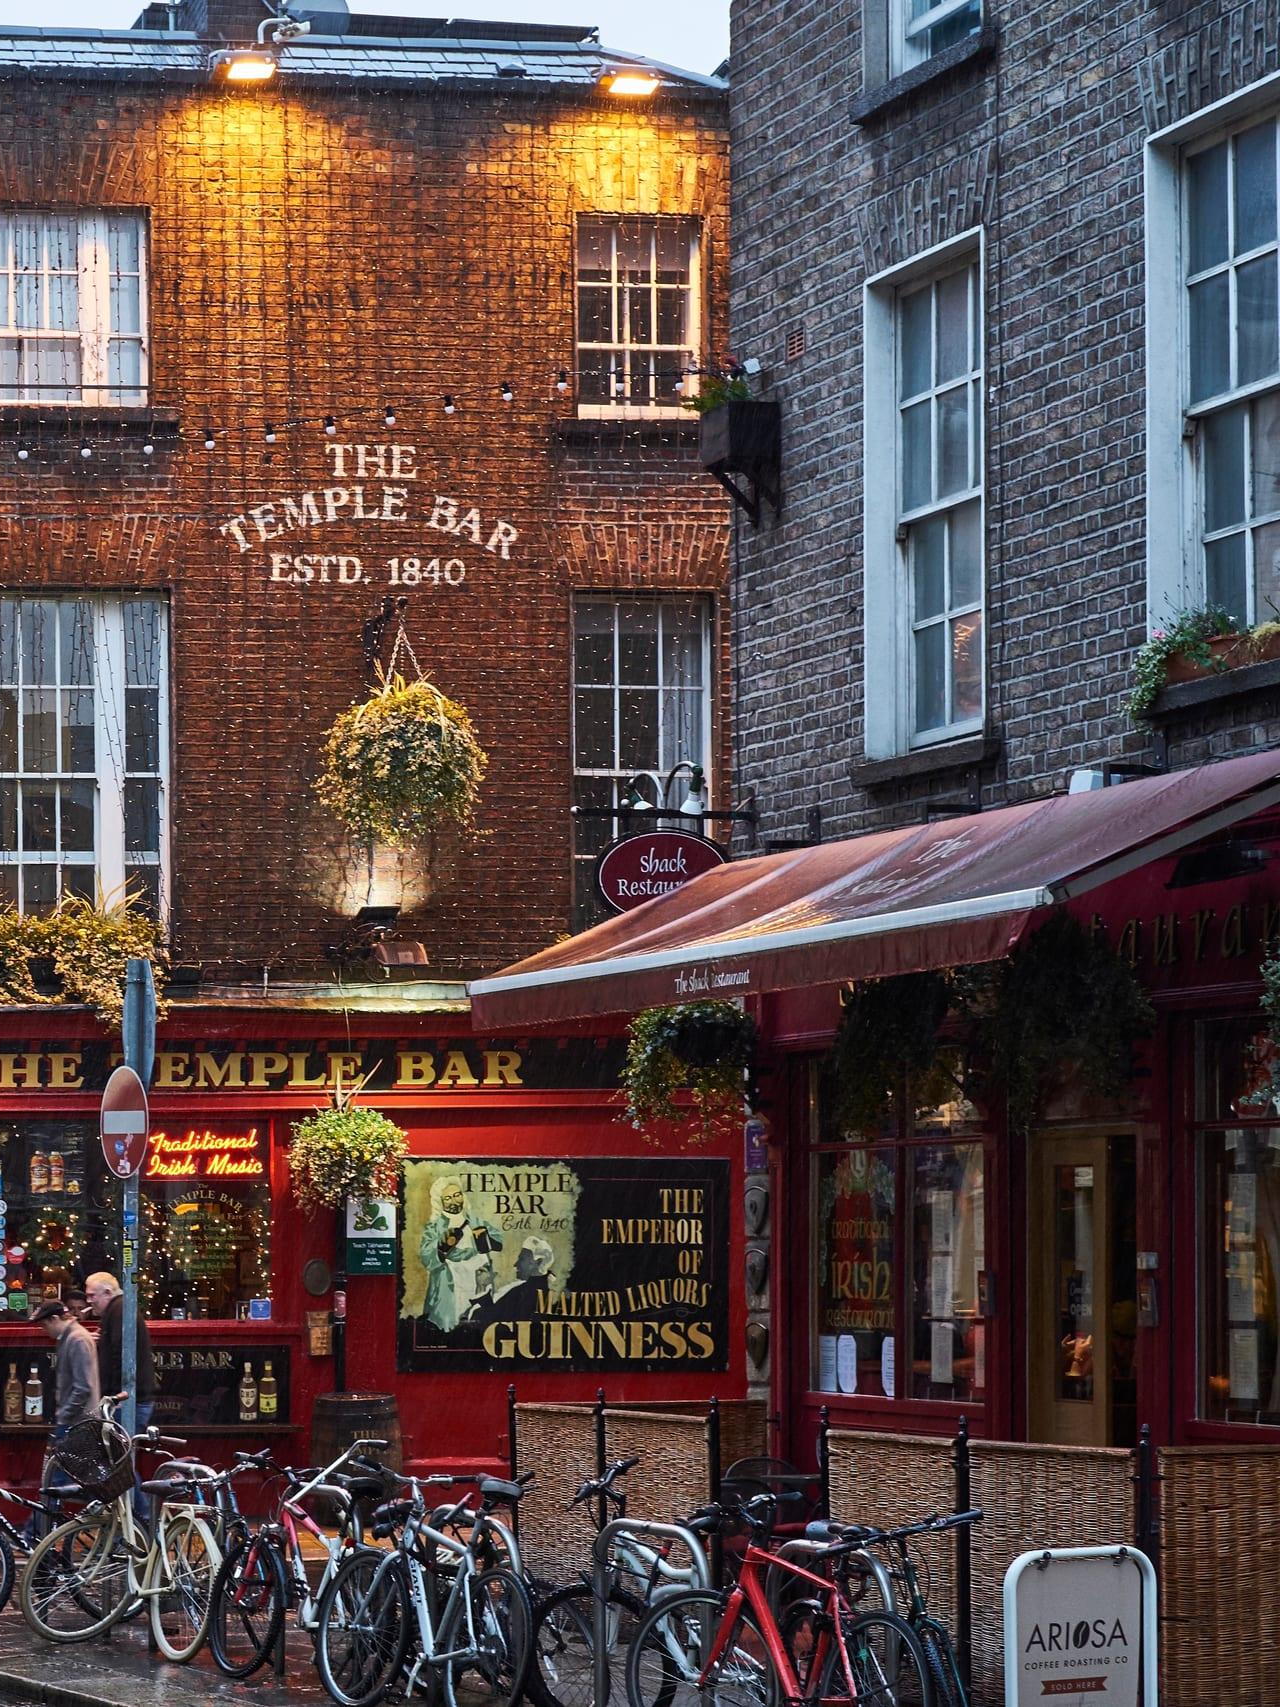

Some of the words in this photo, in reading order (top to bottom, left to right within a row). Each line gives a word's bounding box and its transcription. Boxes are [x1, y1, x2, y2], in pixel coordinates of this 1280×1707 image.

[325, 443, 418, 479] THE
[220, 486, 408, 553] TEMPLE
[427, 495, 519, 560] BAR
[269, 554, 372, 585] ESTD.
[387, 557, 466, 586] 1840
[640, 847, 688, 876] Shack
[617, 879, 684, 897] Restau
[674, 970, 689, 996] The
[110, 1051, 365, 1088] EMPLE
[395, 1050, 524, 1086] BAR
[149, 1128, 258, 1153] Traditional
[146, 1154, 197, 1176] Irish
[206, 1153, 264, 1174] Music
[460, 1173, 574, 1194] TEMPLE
[167, 1190, 216, 1210] TEMPLE
[220, 1193, 243, 1212] BAR
[494, 1194, 548, 1217] BAR
[659, 1188, 704, 1214] THE
[601, 1219, 704, 1245] EMPEROR
[678, 1249, 704, 1275] OF
[534, 1288, 621, 1318] MALTED
[625, 1277, 713, 1313] LIQUORS
[482, 1320, 715, 1360] GUINNESS
[190, 1351, 236, 1369] BAR
[1025, 1617, 1128, 1653] ARIOSA
[1024, 1660, 1059, 1670] COFFEE
[1063, 1657, 1111, 1667] ROASTING
[1115, 1656, 1128, 1664] CO
[1051, 1682, 1073, 1691] SOLD
[1076, 1681, 1097, 1689] HERE
